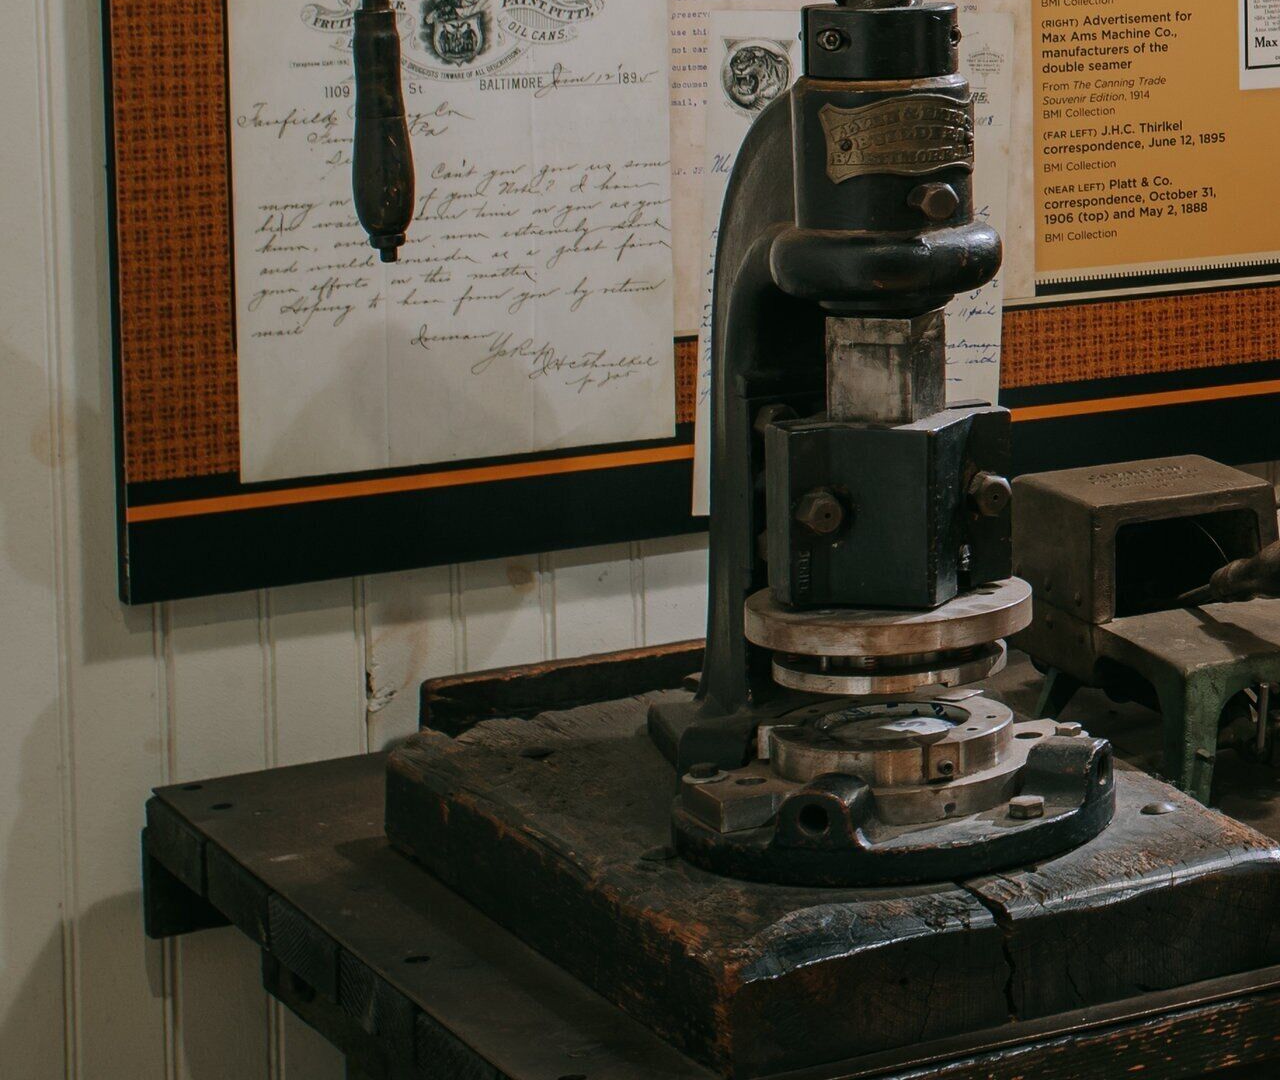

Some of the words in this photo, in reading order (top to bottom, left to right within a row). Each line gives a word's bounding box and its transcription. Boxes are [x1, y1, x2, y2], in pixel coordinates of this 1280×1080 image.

[1040, 17, 1079, 30] (RIGHT)
[1081, 10, 1172, 27] Advertisement
[1174, 9, 1193, 22] for
[507, 21, 527, 38] OIL
[531, 29, 568, 41] CANS.
[1040, 31, 1067, 44] Max
[1069, 30, 1098, 42] Ams
[1100, 26, 1151, 41] Machine
[1153, 25, 1178, 39] Co.,
[1253, 35, 1279, 49] Max
[323, 84, 351, 99] 1109
[478, 75, 544, 92] BALTIMORE
[1042, 129, 1067, 140] (FAR
[1068, 127, 1098, 139] LEFT)
[1100, 122, 1136, 137] J.H.C.
[1138, 118, 1183, 134] Thirlkel
[1042, 138, 1145, 155] correspondence,
[1147, 136, 1177, 148] June
[1178, 133, 1196, 147] 12,
[1197, 131, 1226, 145] 1895
